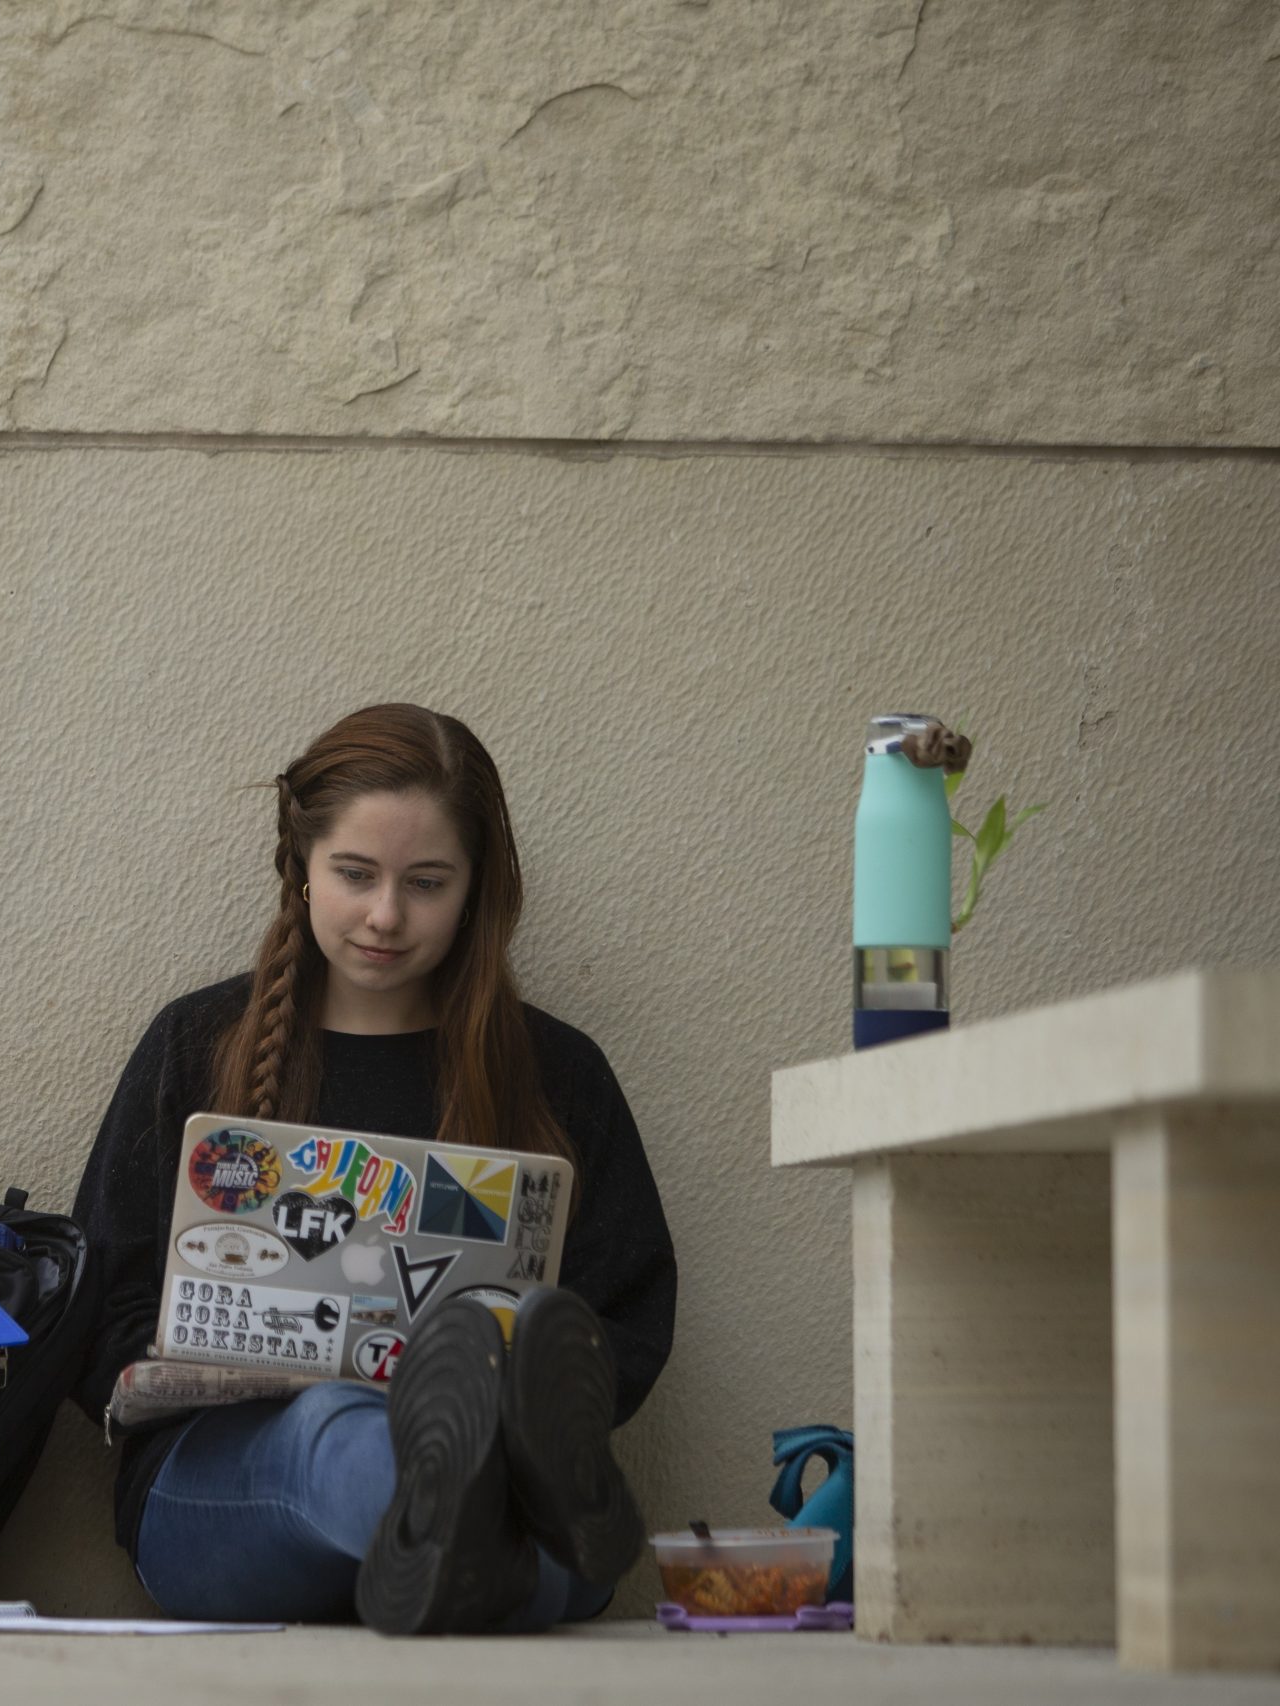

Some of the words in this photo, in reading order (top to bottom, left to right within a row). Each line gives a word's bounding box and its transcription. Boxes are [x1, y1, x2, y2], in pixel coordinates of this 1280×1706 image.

[211, 1168, 258, 1189] MUSIC
[288, 1137, 415, 1234] CALIFORNIA
[277, 1205, 352, 1244] LFK
[179, 1280, 253, 1308] GORA
[176, 1302, 250, 1330] GORA
[173, 1325, 319, 1361] ORKESTAR
